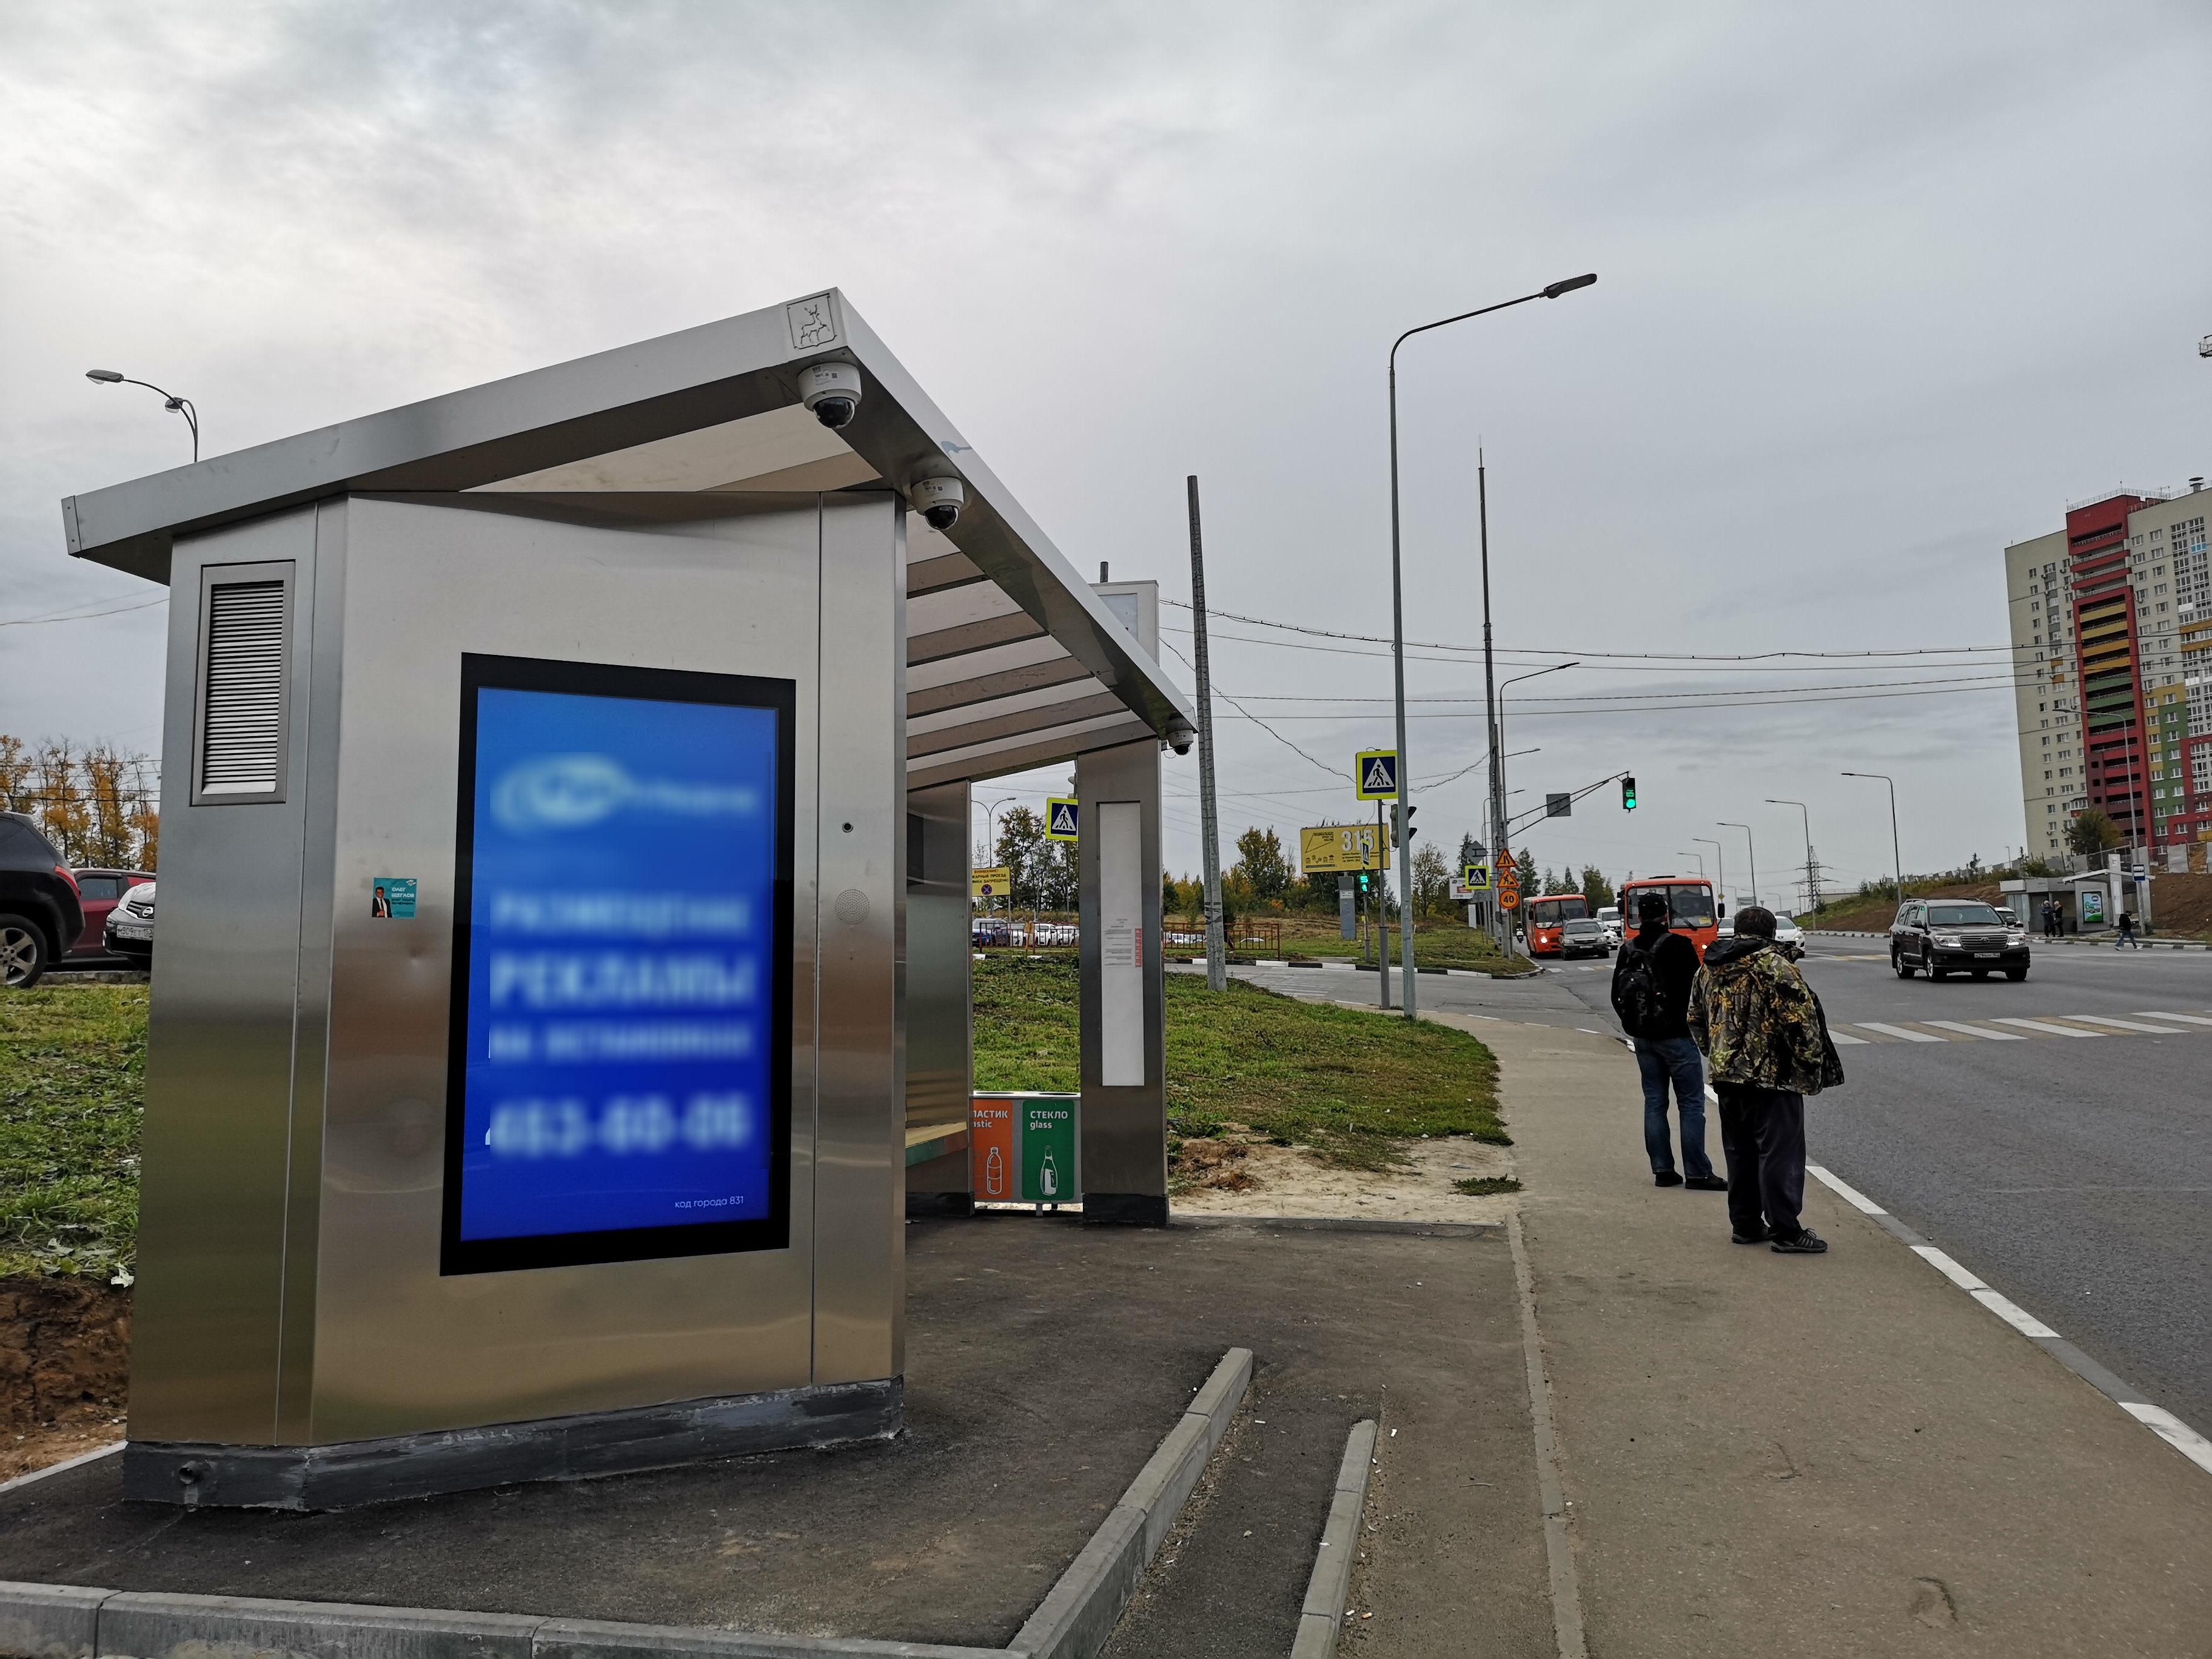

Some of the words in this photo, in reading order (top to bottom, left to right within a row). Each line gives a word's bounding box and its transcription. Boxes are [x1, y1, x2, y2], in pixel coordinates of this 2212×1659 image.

[1341, 829, 1374, 851] 315
[1504, 895, 1515, 903] 40
[1030, 1110, 1068, 1119] СТЕКЛО
[1030, 1120, 1052, 1130] glass
[694, 1199, 728, 1208] города
[729, 1196, 743, 1205] 831
